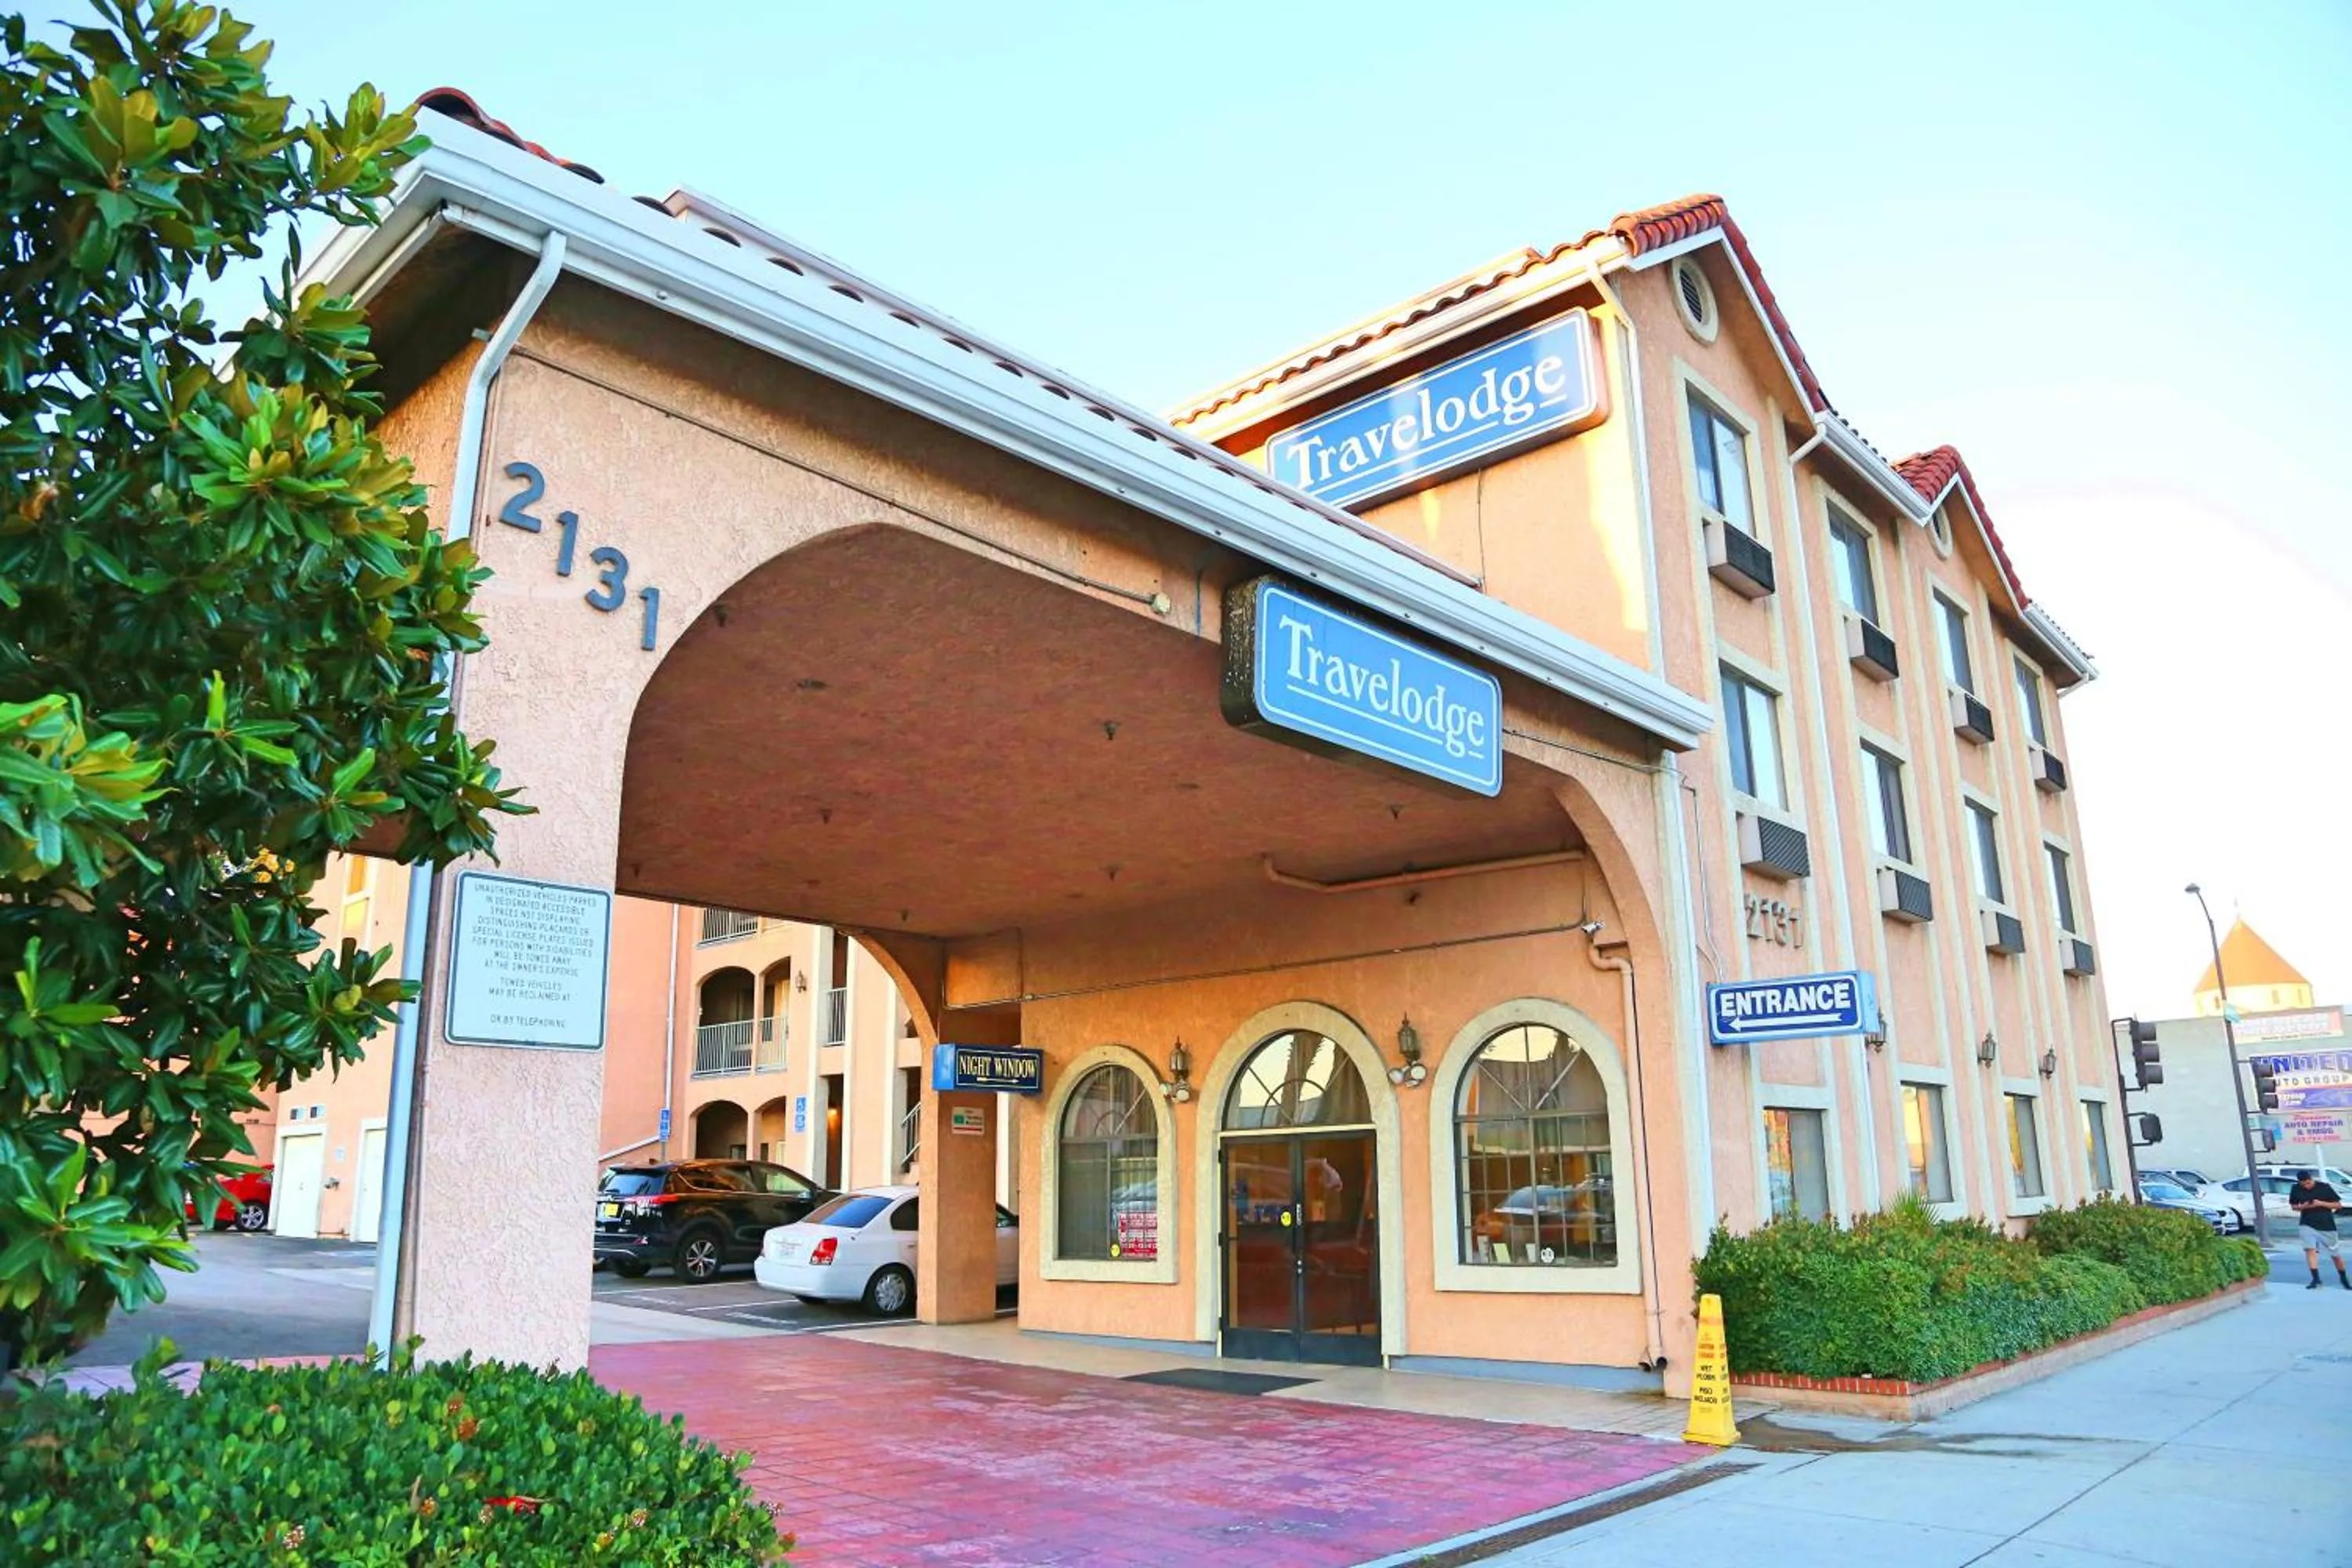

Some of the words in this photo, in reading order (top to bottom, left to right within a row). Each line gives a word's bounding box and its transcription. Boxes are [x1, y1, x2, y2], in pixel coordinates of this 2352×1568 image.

[1286, 355, 1566, 492] Travelodge
[499, 461, 660, 652] 2131
[1279, 614, 1484, 757] Travelodge
[1720, 982, 1851, 1017] ENTRANCE
[959, 1054, 992, 1076] NIGHT
[994, 1057, 1037, 1079] WINDOW
[2274, 1076, 2299, 1086] UTO
